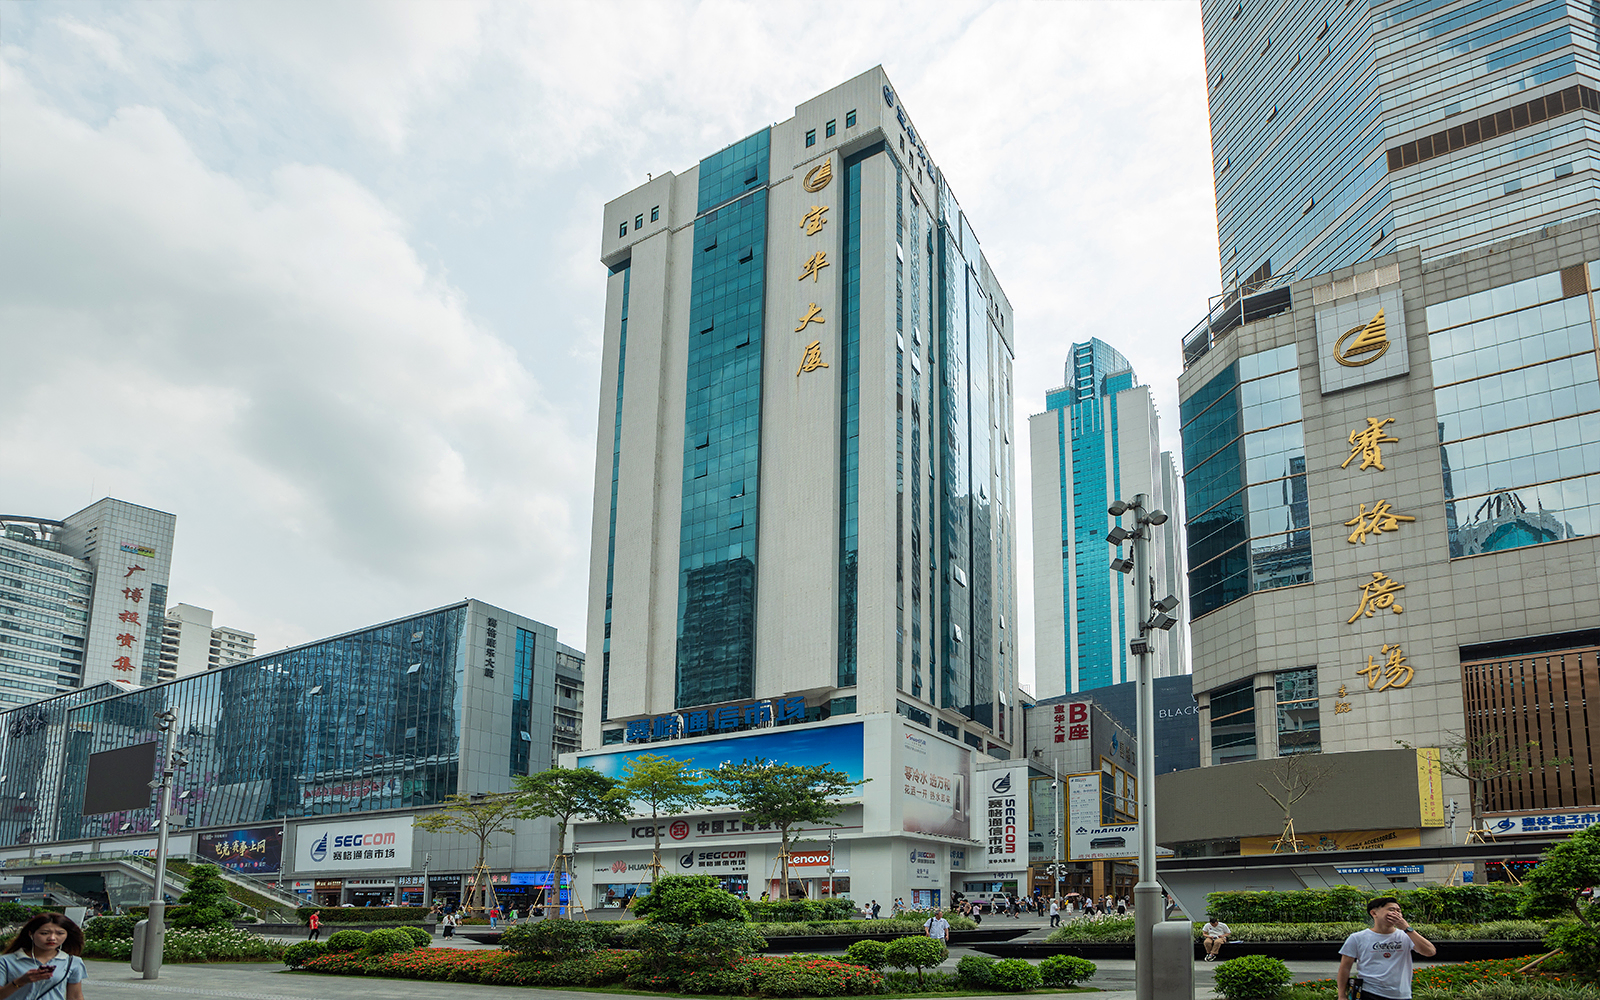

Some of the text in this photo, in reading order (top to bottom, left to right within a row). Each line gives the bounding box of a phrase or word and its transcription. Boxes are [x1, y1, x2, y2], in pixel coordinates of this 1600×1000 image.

[795, 205, 830, 377] 宝华大厦
[111, 564, 146, 685] 广博投资集
[626, 696, 805, 743] 赛格通信市场
[1159, 706, 1200, 719] BLACK
[1054, 704, 1065, 743] 宝华大厦
[988, 800, 1003, 854] 赛格通信市场
[1005, 799, 1016, 853] SEGCOM
[1522, 813, 1600, 827] 赛格电子市
[631, 825, 666, 839] ICBC
[334, 832, 395, 848] SEGCOM
[132, 848, 169, 858] SEGC
[333, 848, 395, 861] 赛格通信市场
[698, 850, 746, 860] SEGCOM
[788, 855, 829, 864] Lenovo
[628, 863, 653, 871] HUAW
